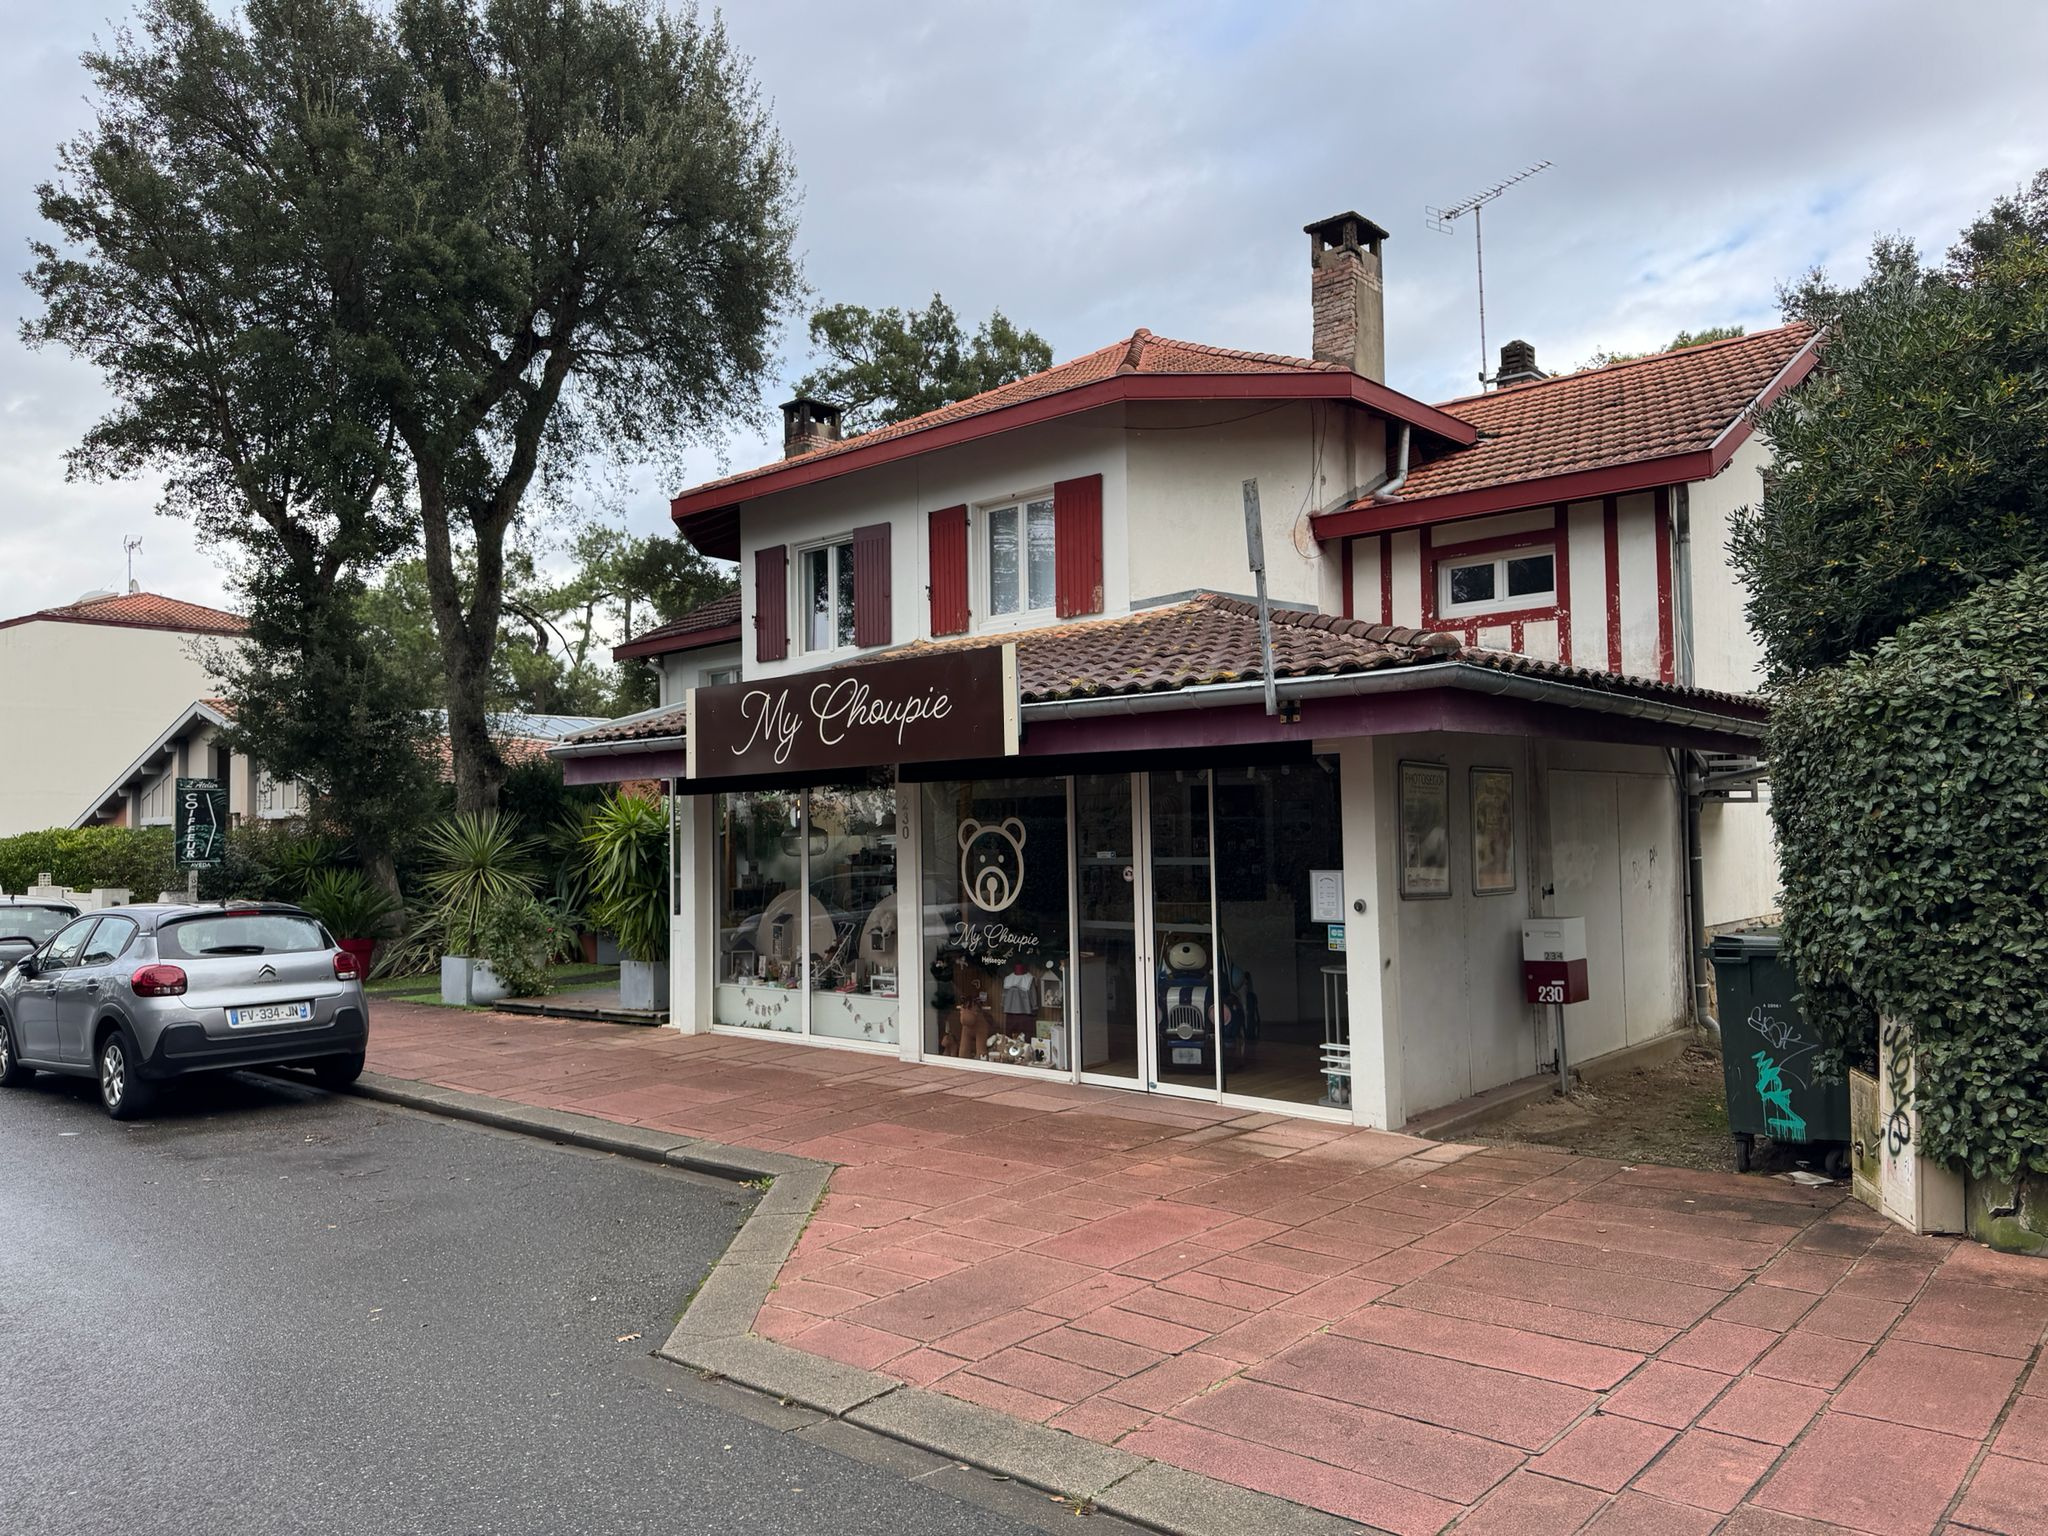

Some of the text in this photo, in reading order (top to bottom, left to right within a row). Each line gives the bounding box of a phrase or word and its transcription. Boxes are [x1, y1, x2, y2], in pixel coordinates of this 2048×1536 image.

[731, 677, 953, 765] My Choupie
[184, 792, 199, 858] COIFFEUR
[901, 795, 910, 840] 230
[950, 921, 1040, 953] My Choupie
[1538, 985, 1564, 1003] 230
[239, 1005, 299, 1022] FV-334-JN
